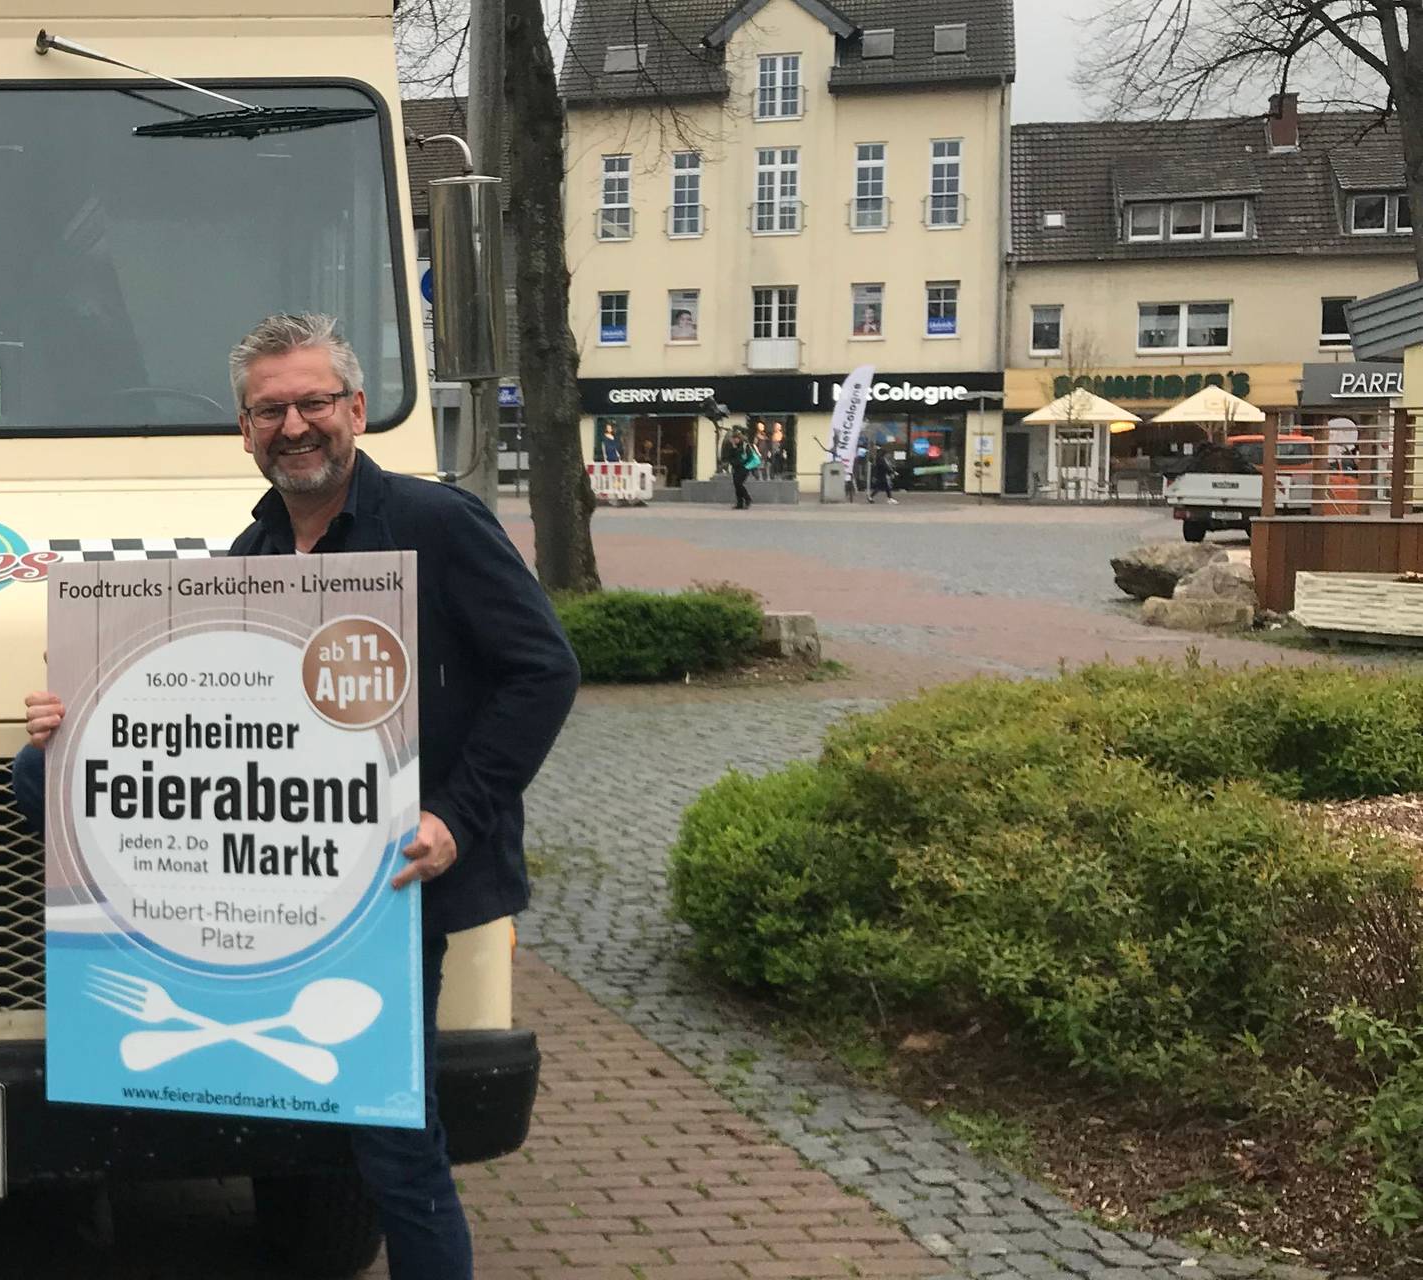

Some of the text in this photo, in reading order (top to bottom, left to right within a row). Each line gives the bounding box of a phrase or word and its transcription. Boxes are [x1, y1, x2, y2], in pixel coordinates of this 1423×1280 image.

[609, 387, 715, 403] GERRY WEBER
[833, 382, 968, 405] Cologne
[59, 571, 404, 600] Foodtrucks Garküchen Livemusik
[319, 634, 390, 662] ab 11.
[244, 671, 274, 687] Uhr
[316, 668, 394, 709] April
[112, 713, 300, 757] Bergheimer
[85, 759, 378, 824] Feierabend
[119, 834, 209, 852] jeden 2. Do
[222, 833, 339, 877] Markt
[134, 856, 209, 874] im Monat
[132, 899, 327, 926] Hubert-Rheinfeld-
[201, 927, 255, 950] Platz
[122, 1086, 340, 1113] www.feierabendmarkt-bm.de
